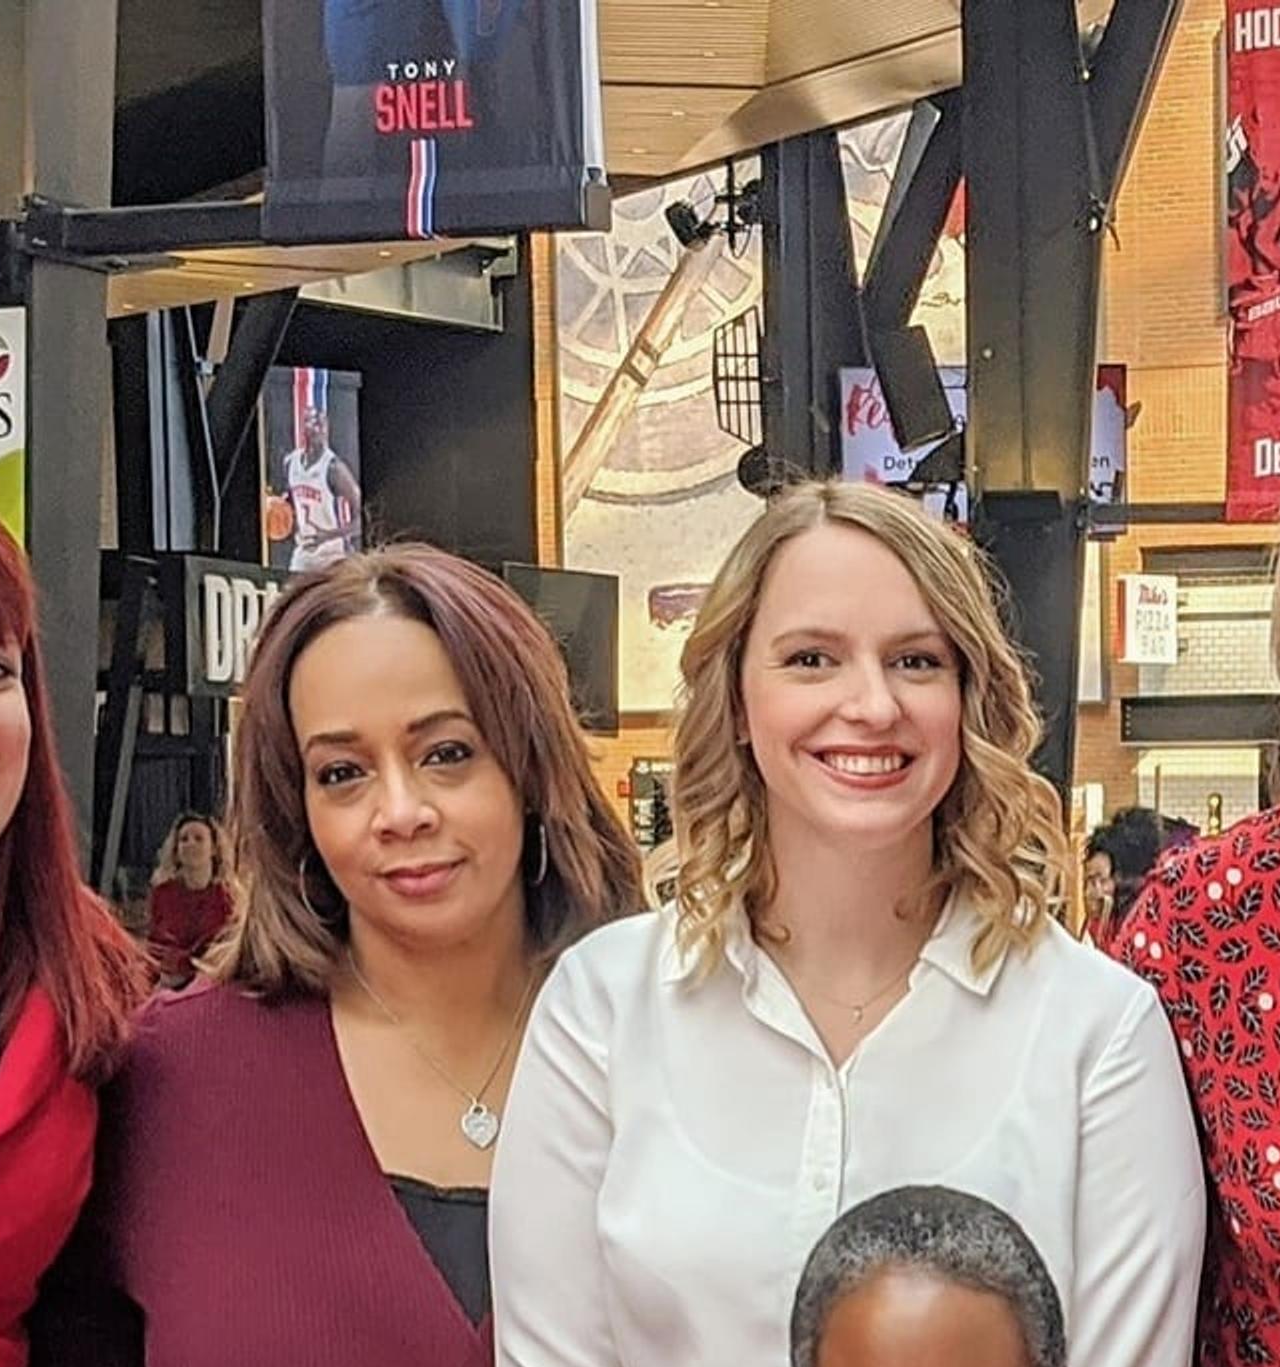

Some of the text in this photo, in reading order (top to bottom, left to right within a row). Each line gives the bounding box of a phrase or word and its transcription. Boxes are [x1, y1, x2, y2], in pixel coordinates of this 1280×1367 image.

[387, 60, 456, 80] TONY
[375, 80, 473, 132] SNELL
[883, 455, 918, 471] Det
